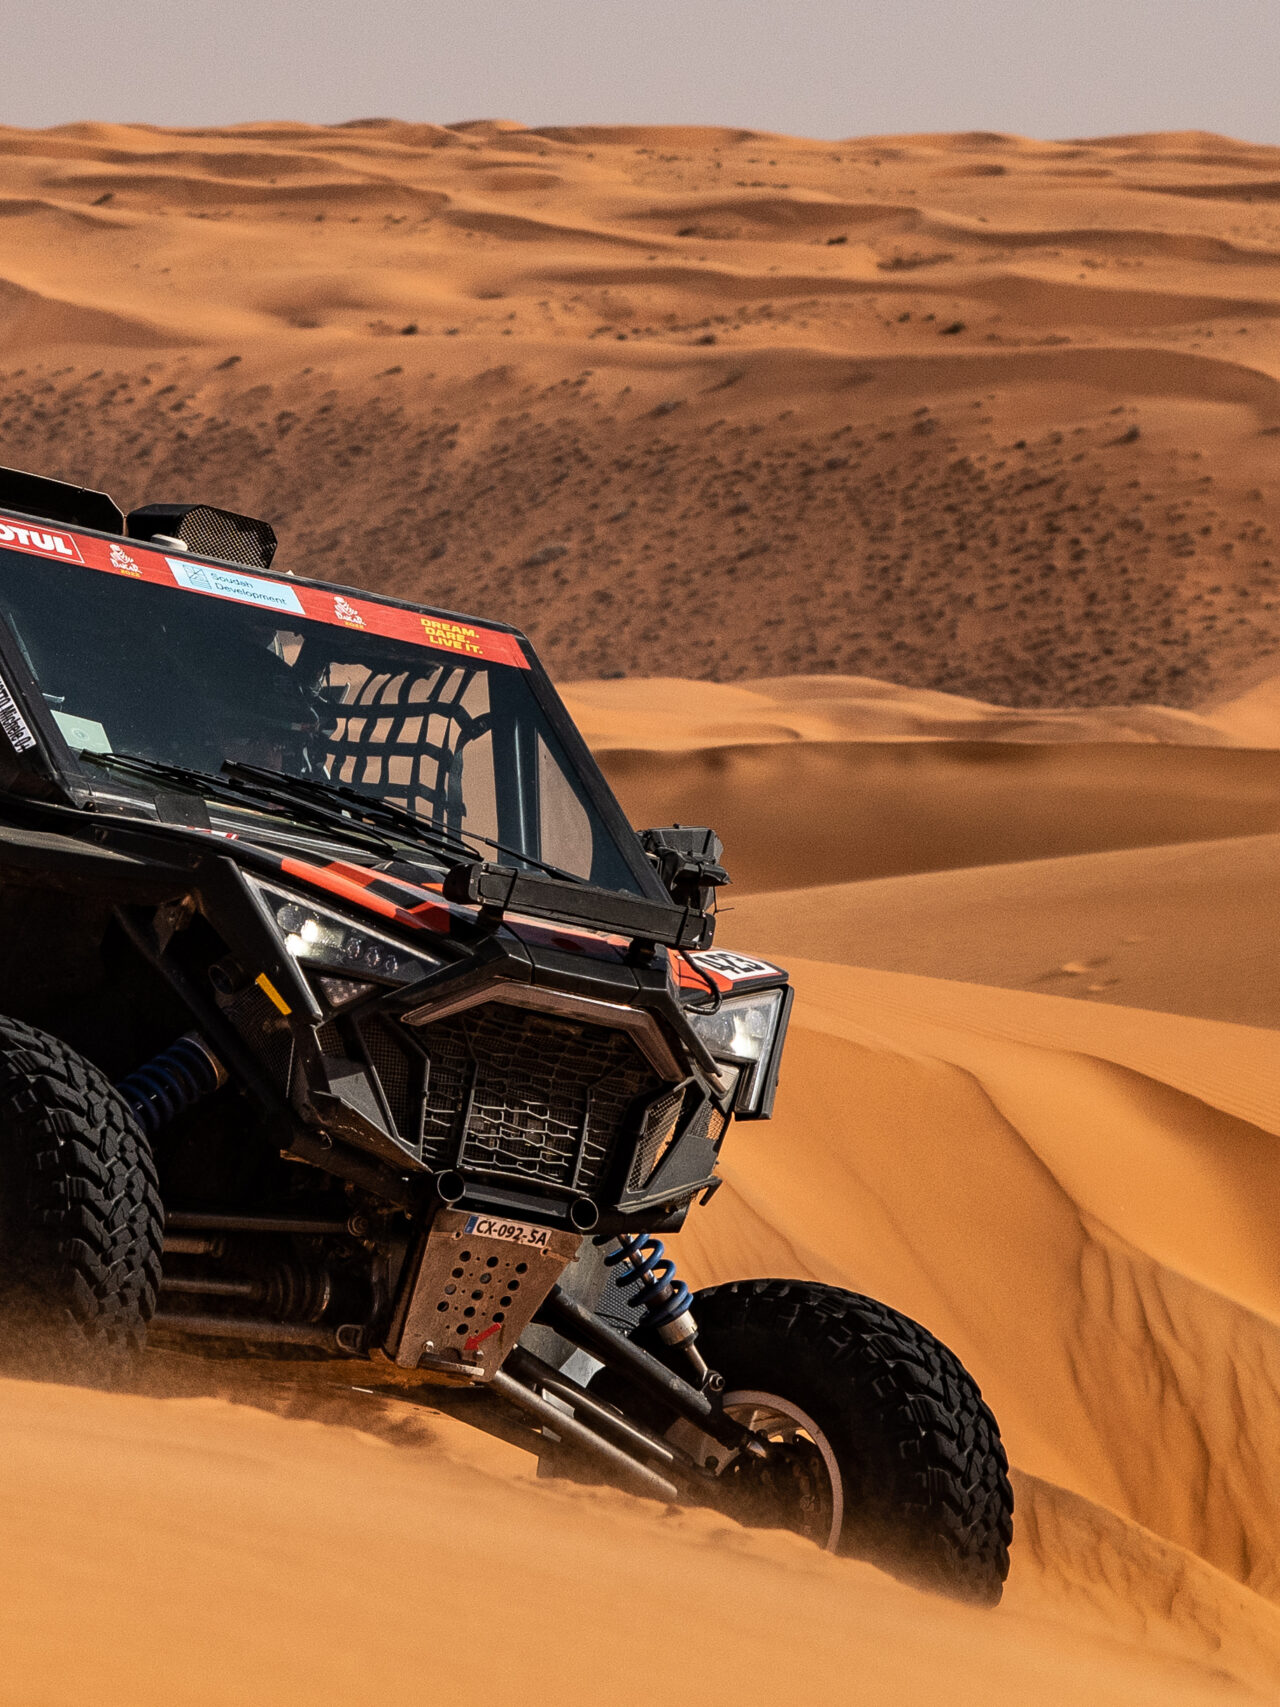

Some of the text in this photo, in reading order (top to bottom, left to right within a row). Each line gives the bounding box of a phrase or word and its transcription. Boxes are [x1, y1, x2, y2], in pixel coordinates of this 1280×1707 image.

[210, 572, 254, 589] Soudah
[215, 582, 288, 605] Development
[420, 618, 480, 639] DREAM.
[424, 627, 470, 644] DARE.
[429, 636, 484, 655] LIVE IT.
